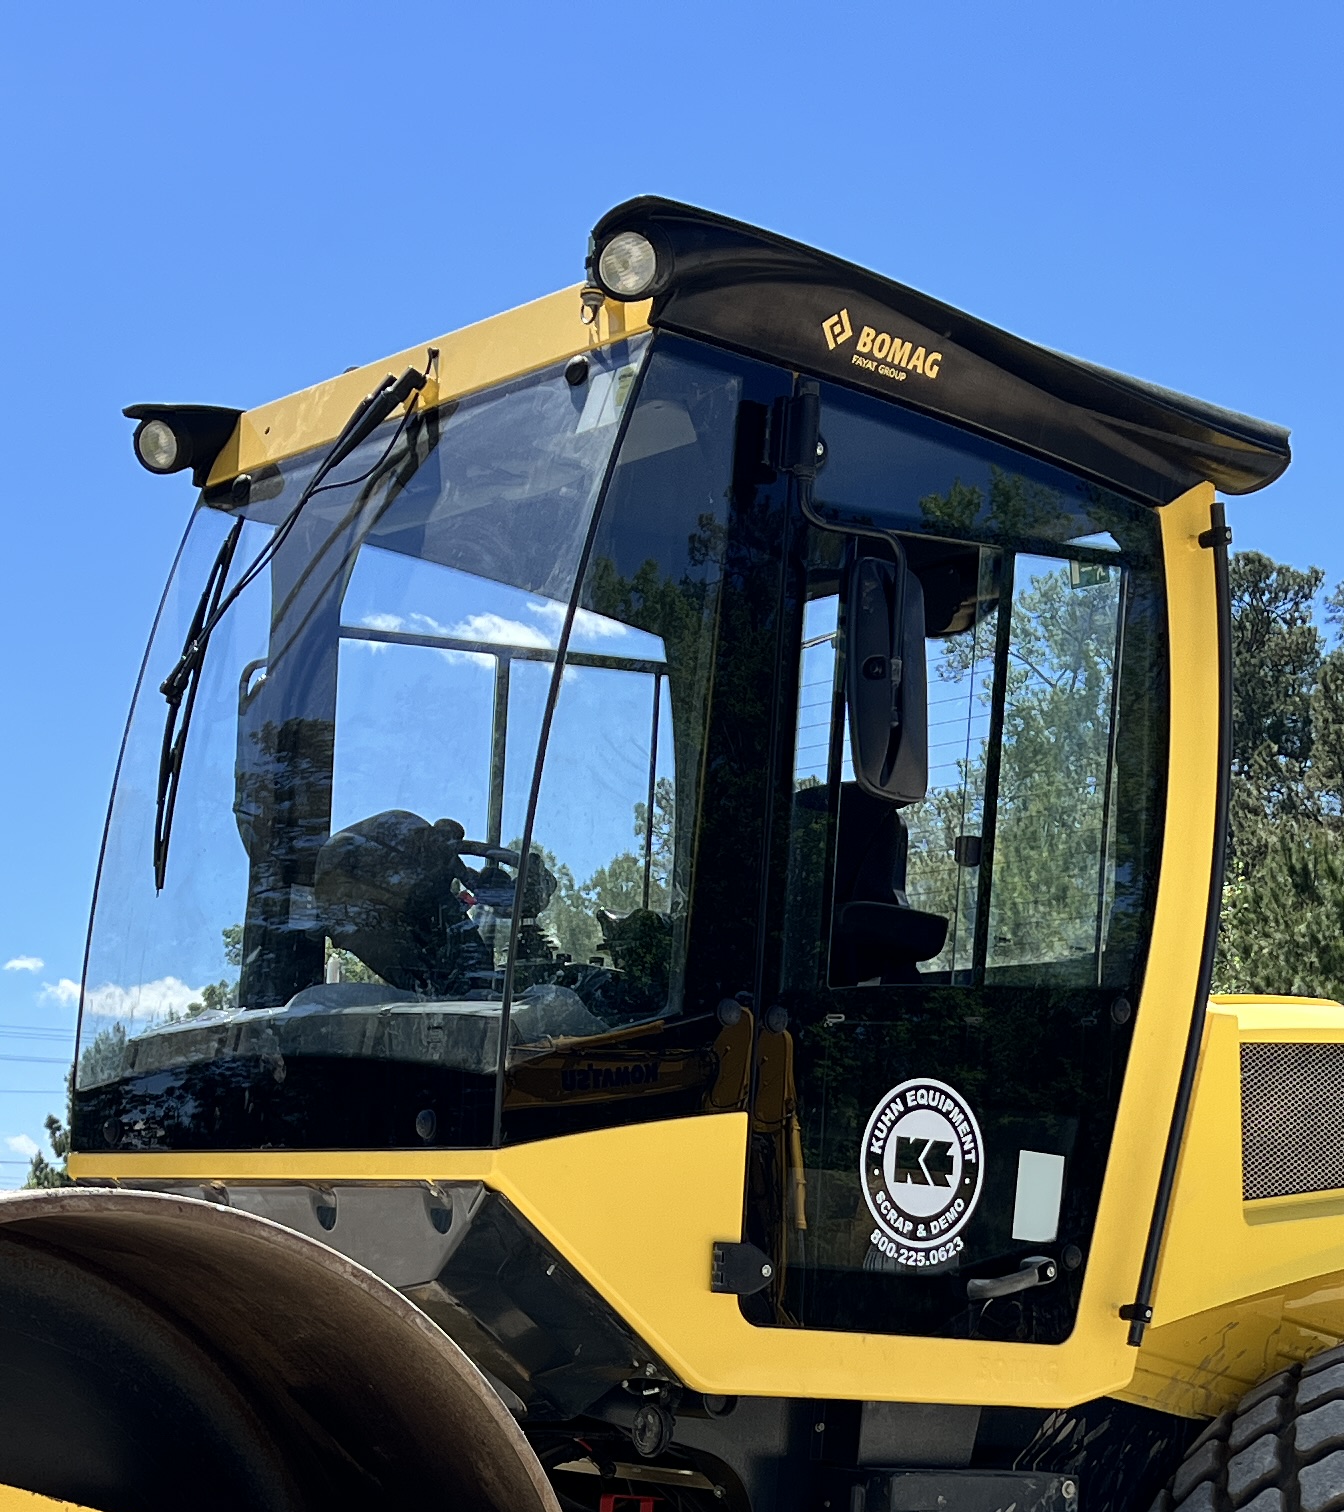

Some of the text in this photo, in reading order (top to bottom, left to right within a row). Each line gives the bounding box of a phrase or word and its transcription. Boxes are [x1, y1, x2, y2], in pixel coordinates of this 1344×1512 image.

[851, 354, 907, 382] FAYAT GROUP
[856, 325, 943, 379] BOMAG
[870, 1088, 976, 1163] KUHN EQUIPMENT
[875, 1190, 965, 1238] SCRAP & DEMO
[869, 1228, 965, 1267] 800.225.0623
